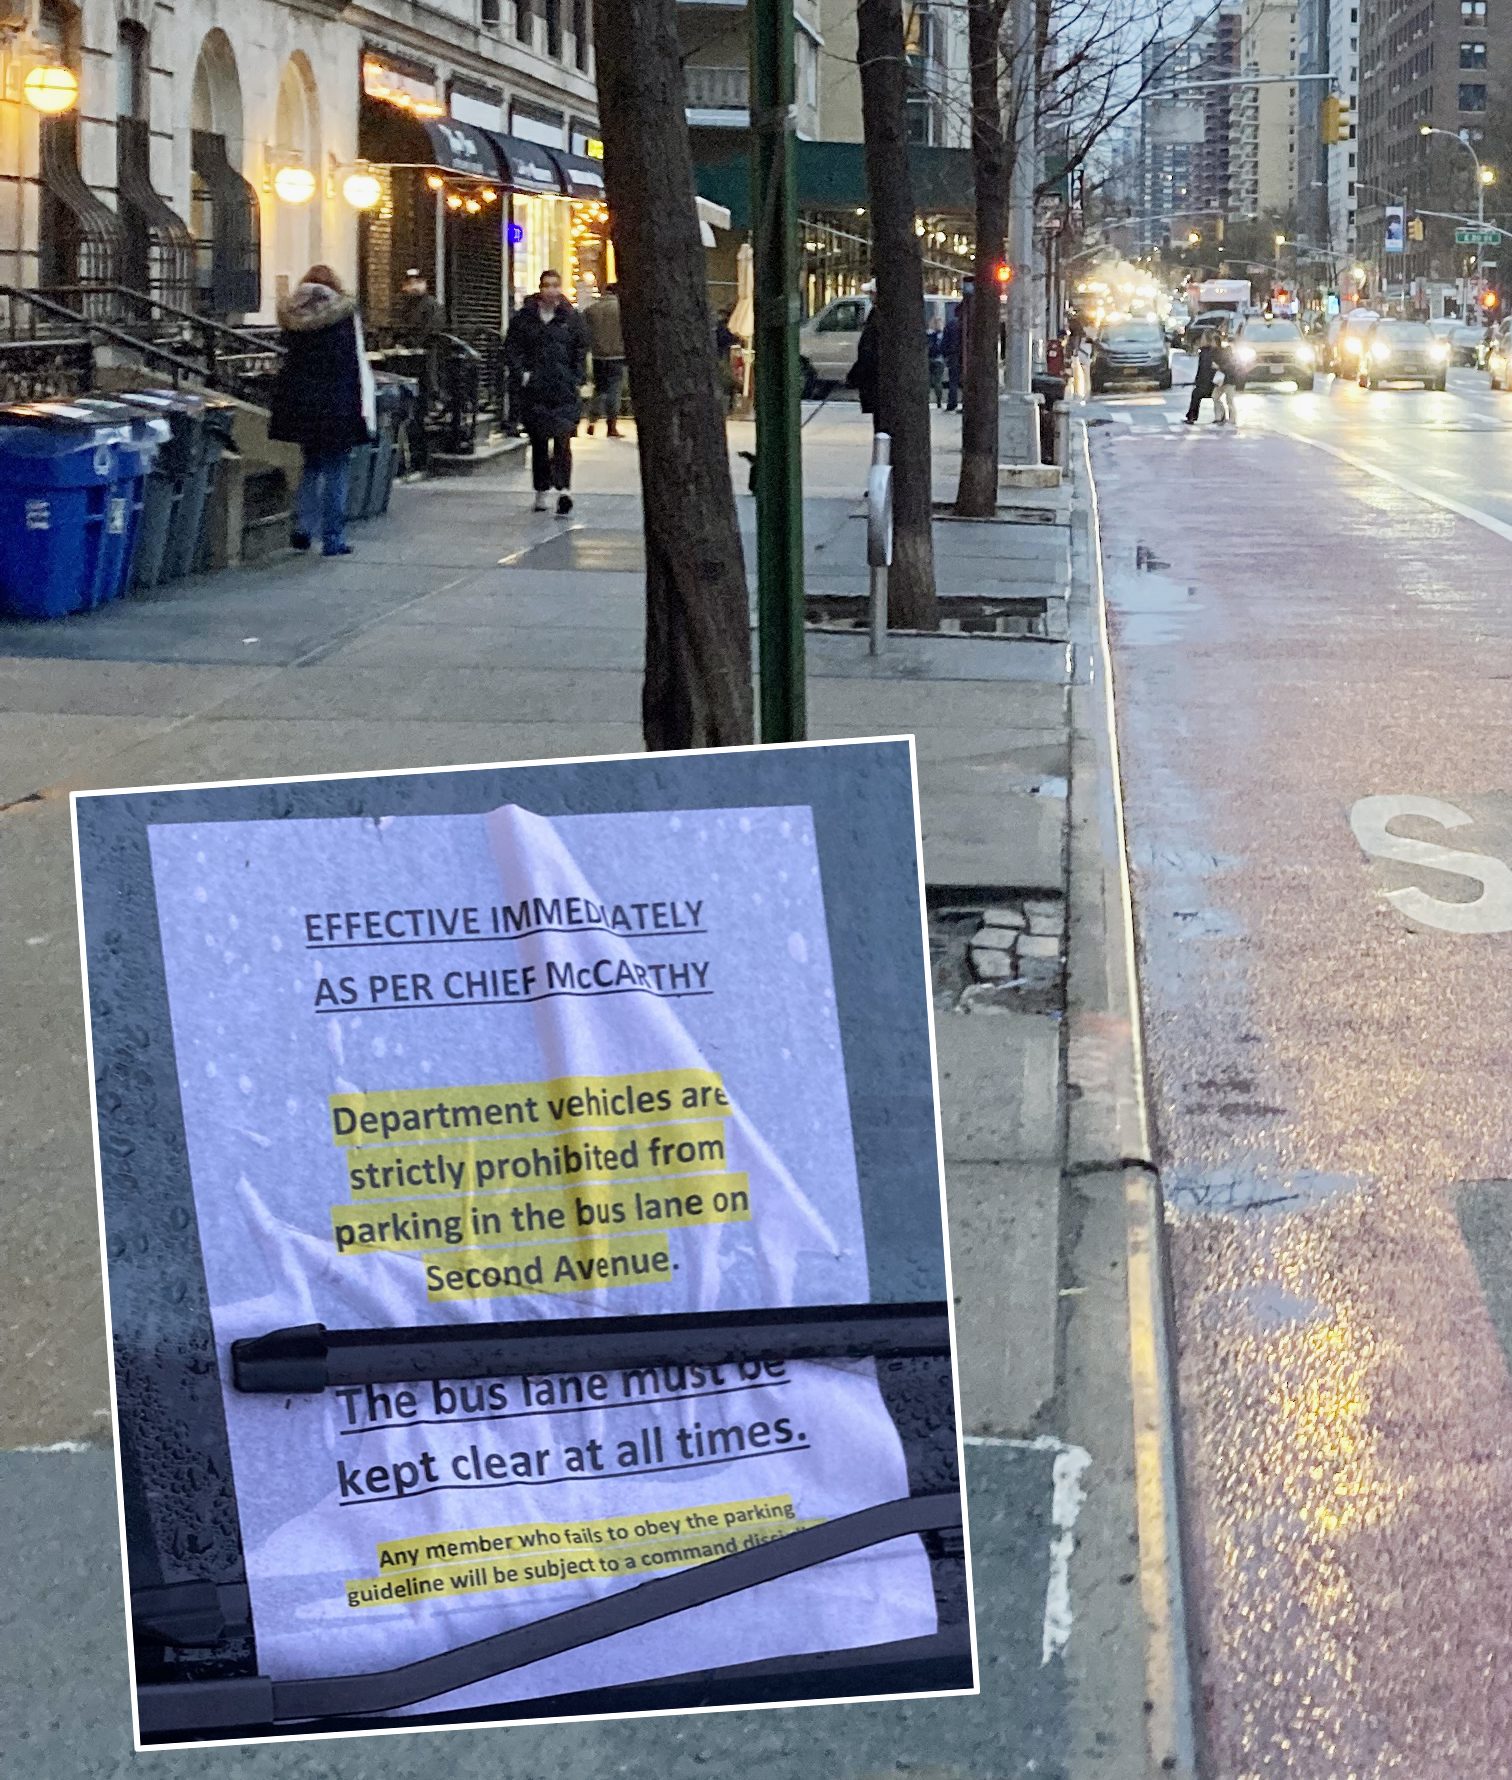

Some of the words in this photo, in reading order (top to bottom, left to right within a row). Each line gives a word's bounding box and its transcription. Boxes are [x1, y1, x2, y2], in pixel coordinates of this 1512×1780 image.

[305, 907, 481, 942] EFFECTIVE
[492, 897, 704, 933] IMMEDIATELY
[314, 977, 358, 1007] AS
[371, 974, 432, 1004] PER
[444, 966, 537, 999] CHIEF
[547, 960, 710, 991] McCARTHY
[333, 1098, 540, 1139] Department
[547, 1084, 671, 1121] vehicles
[682, 1087, 730, 1109] are
[350, 1155, 466, 1191] strictly
[475, 1140, 641, 1187] prohibited
[648, 1136, 725, 1167] from
[334, 1210, 464, 1251] parking
[471, 1205, 501, 1236] in
[511, 1202, 567, 1232] the
[576, 1196, 627, 1227] bus
[635, 1191, 704, 1220] lane
[712, 1187, 750, 1214] on
[425, 1257, 545, 1293] Second
[554, 1248, 680, 1283] Avenue.
[336, 1384, 417, 1424] The
[433, 1379, 507, 1415] bus
[523, 1374, 608, 1407] lane
[337, 1452, 439, 1497] kept
[452, 1445, 550, 1480] clear
[565, 1439, 604, 1472] at
[617, 1427, 663, 1467] all
[677, 1417, 806, 1459] times.
[379, 1547, 420, 1568] Any
[426, 1535, 513, 1560] member
[517, 1529, 561, 1548] who
[564, 1526, 603, 1544] fails
[607, 1526, 629, 1541] to
[633, 1519, 681, 1537] obey
[686, 1513, 719, 1530] the
[724, 1503, 796, 1527] parking
[347, 1577, 445, 1608] guideline
[450, 1568, 488, 1589] will
[494, 1566, 519, 1584] be
[524, 1557, 596, 1580] subject
[599, 1557, 620, 1572] to
[625, 1557, 637, 1569] a
[641, 1537, 739, 1566] command
